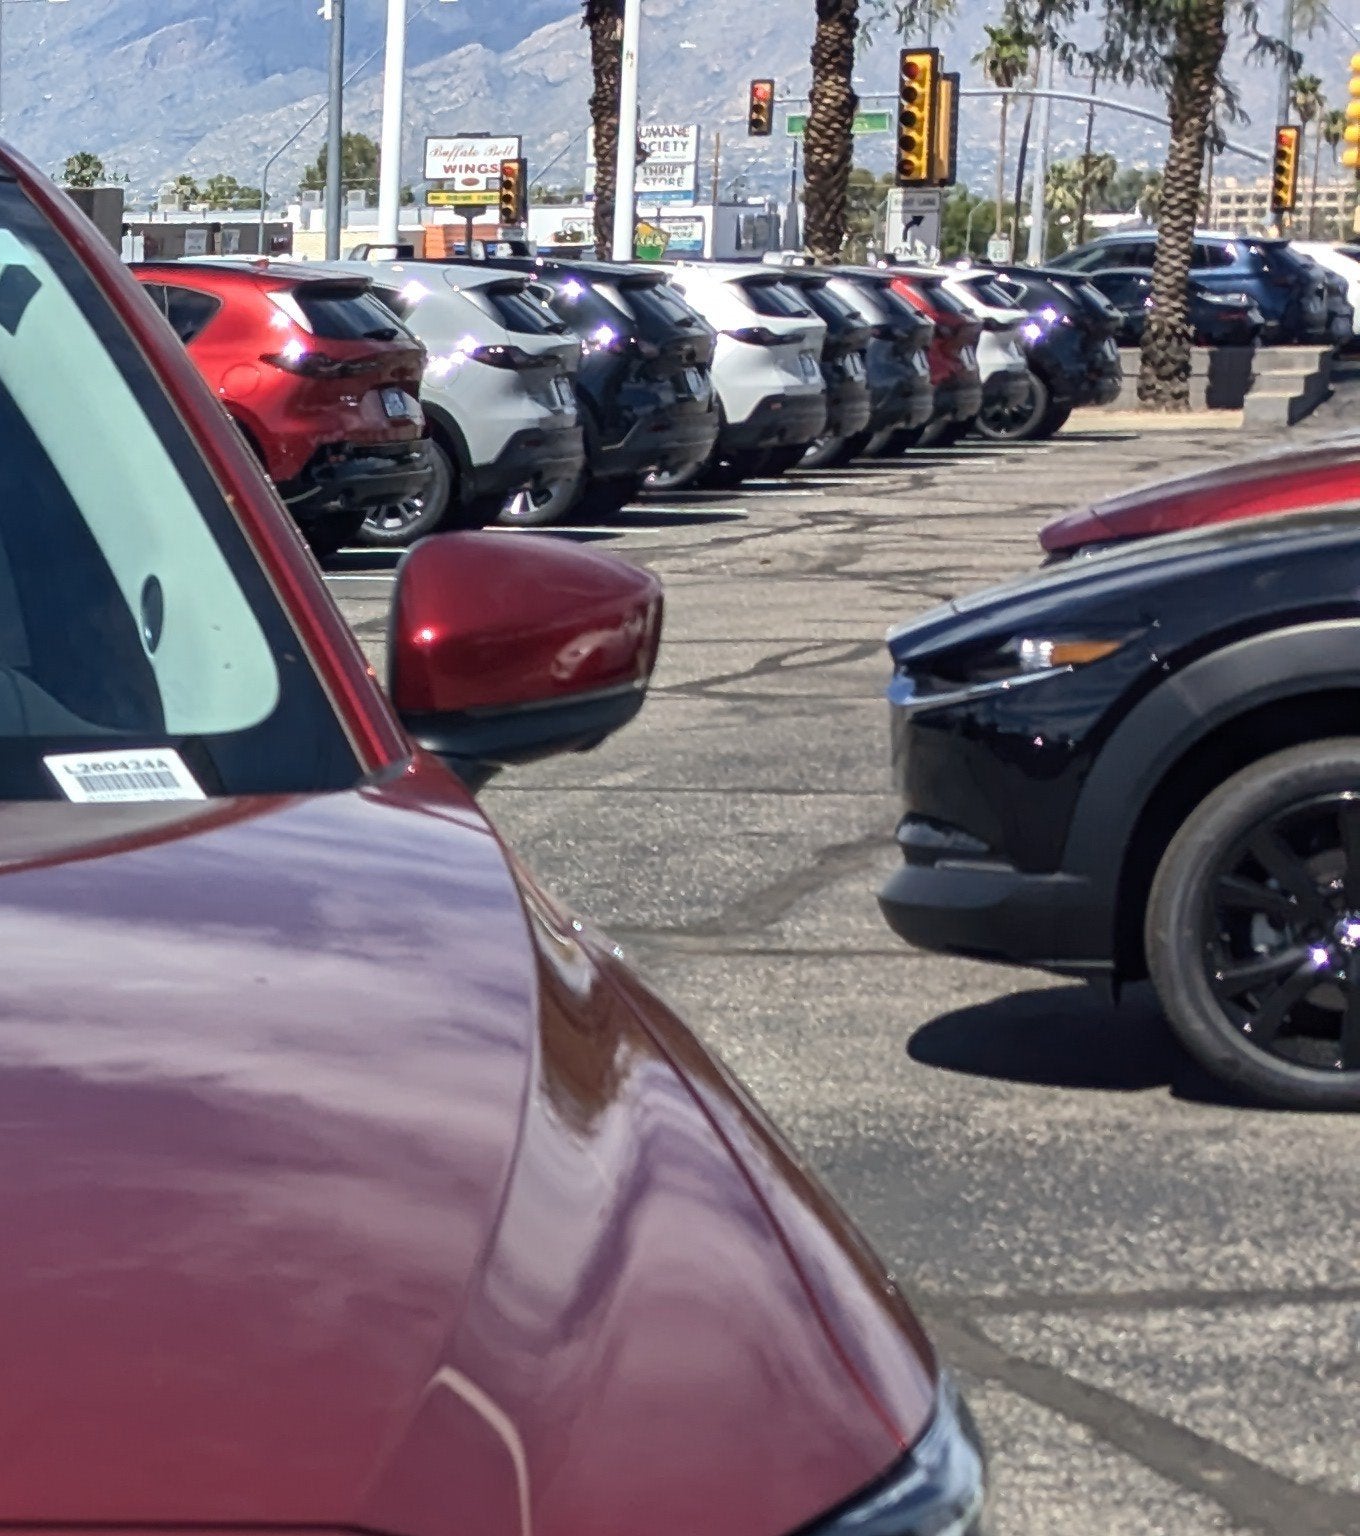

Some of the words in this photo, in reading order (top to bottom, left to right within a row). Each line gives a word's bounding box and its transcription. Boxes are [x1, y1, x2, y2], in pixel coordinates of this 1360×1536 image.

[639, 126, 690, 138] UMANE
[640, 140, 688, 152] OCIETY
[443, 163, 500, 174] WINGS
